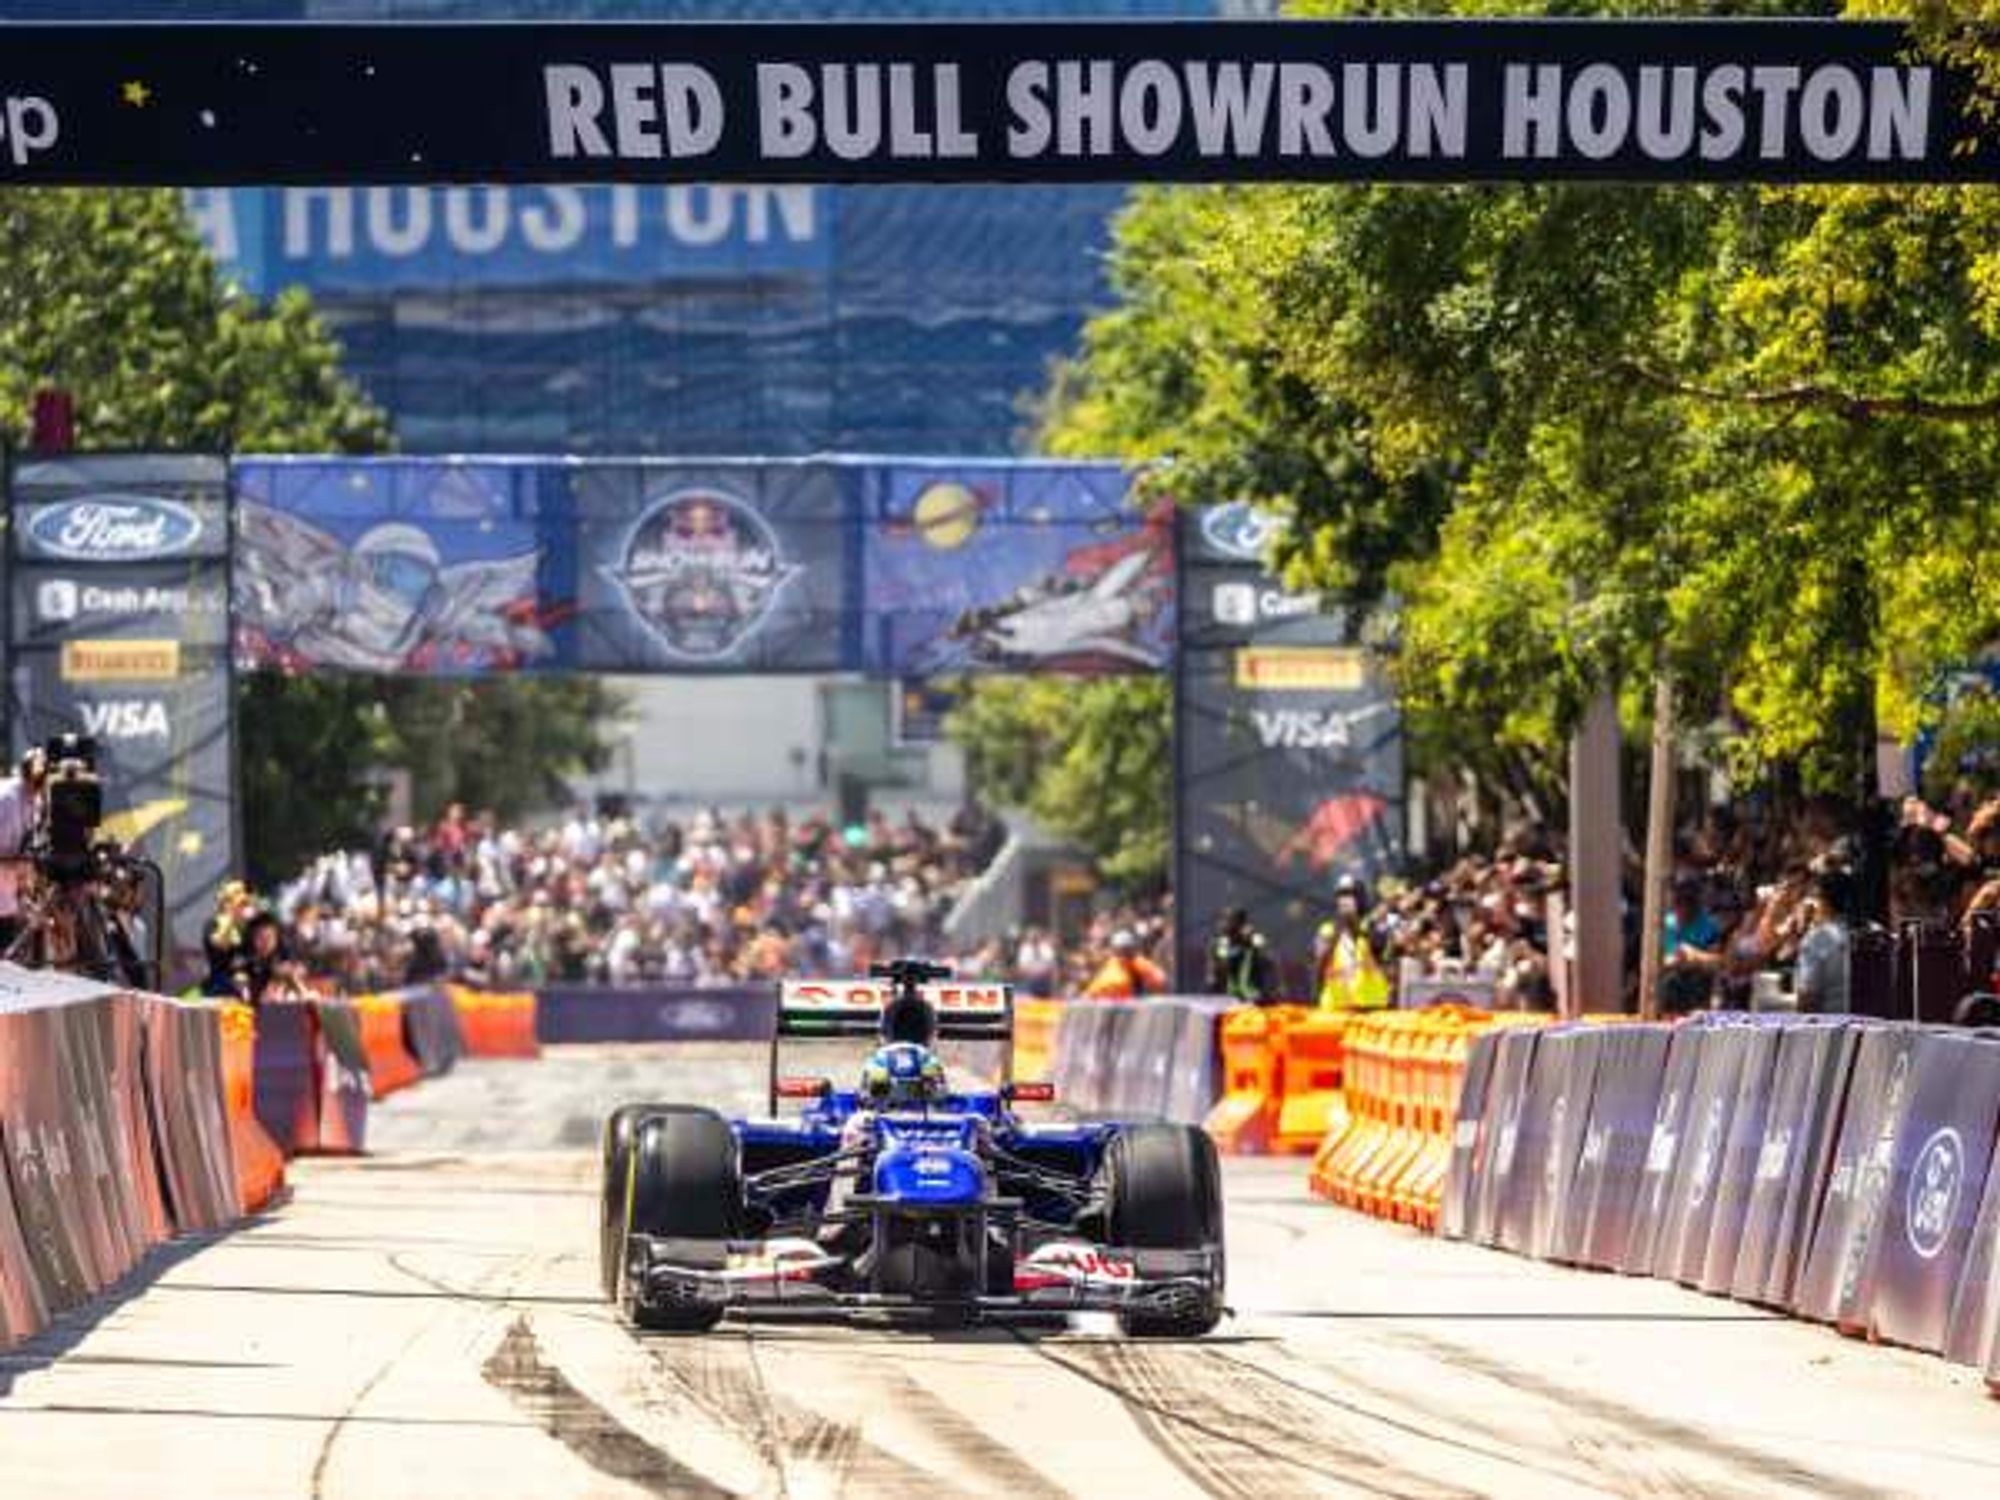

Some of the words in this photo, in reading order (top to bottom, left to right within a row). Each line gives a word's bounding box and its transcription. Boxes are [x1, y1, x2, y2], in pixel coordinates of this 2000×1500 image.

[544, 64, 724, 158] RED
[757, 63, 978, 159] BULL
[1005, 60, 1468, 158] SHOWRUN
[1503, 63, 1932, 161] HOUSTON
[61, 504, 166, 547] Ford
[76, 701, 169, 737] VISA
[1252, 709, 1349, 747] VISA
